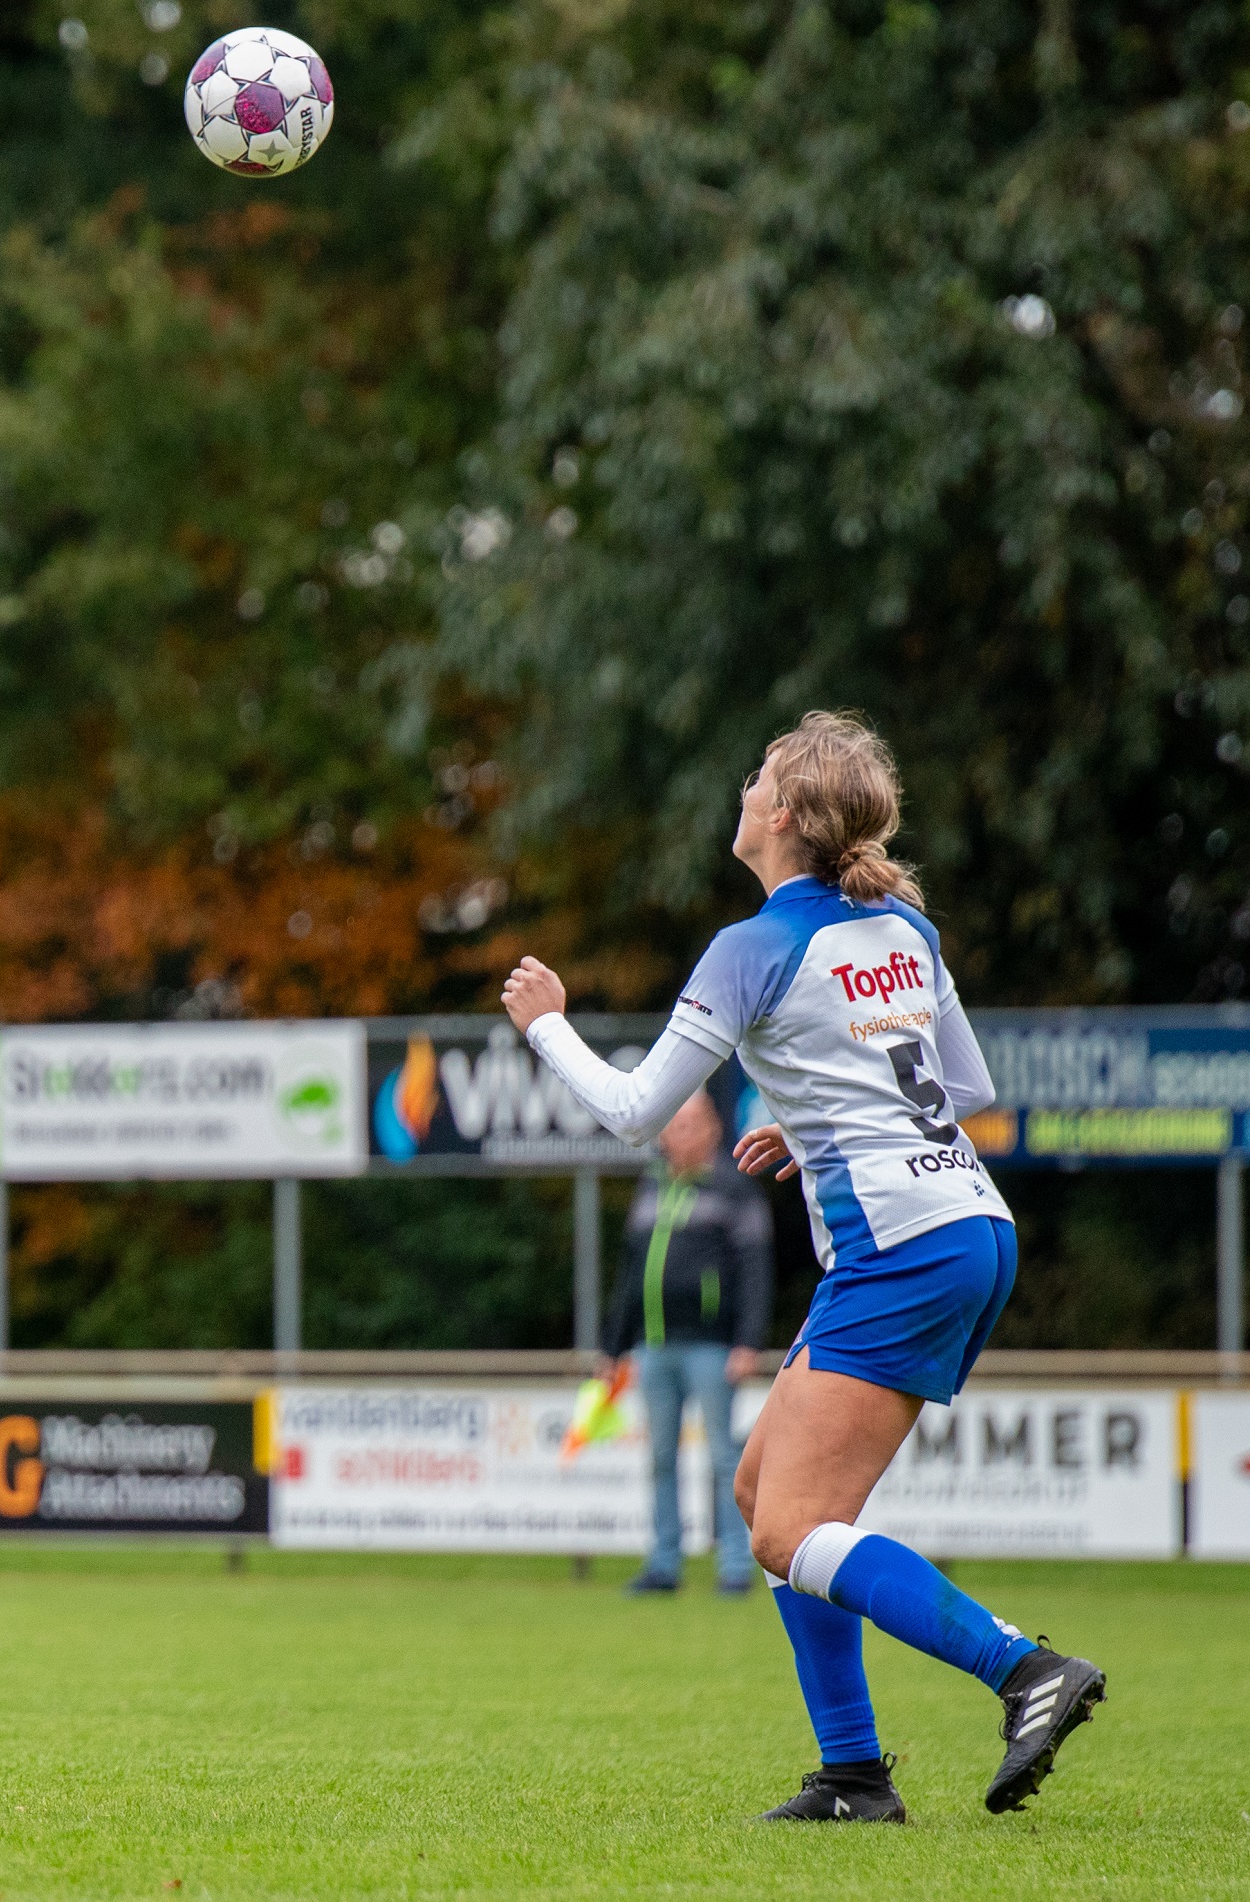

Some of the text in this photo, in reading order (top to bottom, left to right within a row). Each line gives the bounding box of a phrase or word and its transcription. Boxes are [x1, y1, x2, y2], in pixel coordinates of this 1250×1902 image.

[831, 952, 924, 1005] Topfit
[887, 1041, 960, 1147] 5
[905, 1149, 983, 1178] rosco
[910, 1408, 1144, 1470] MMER
